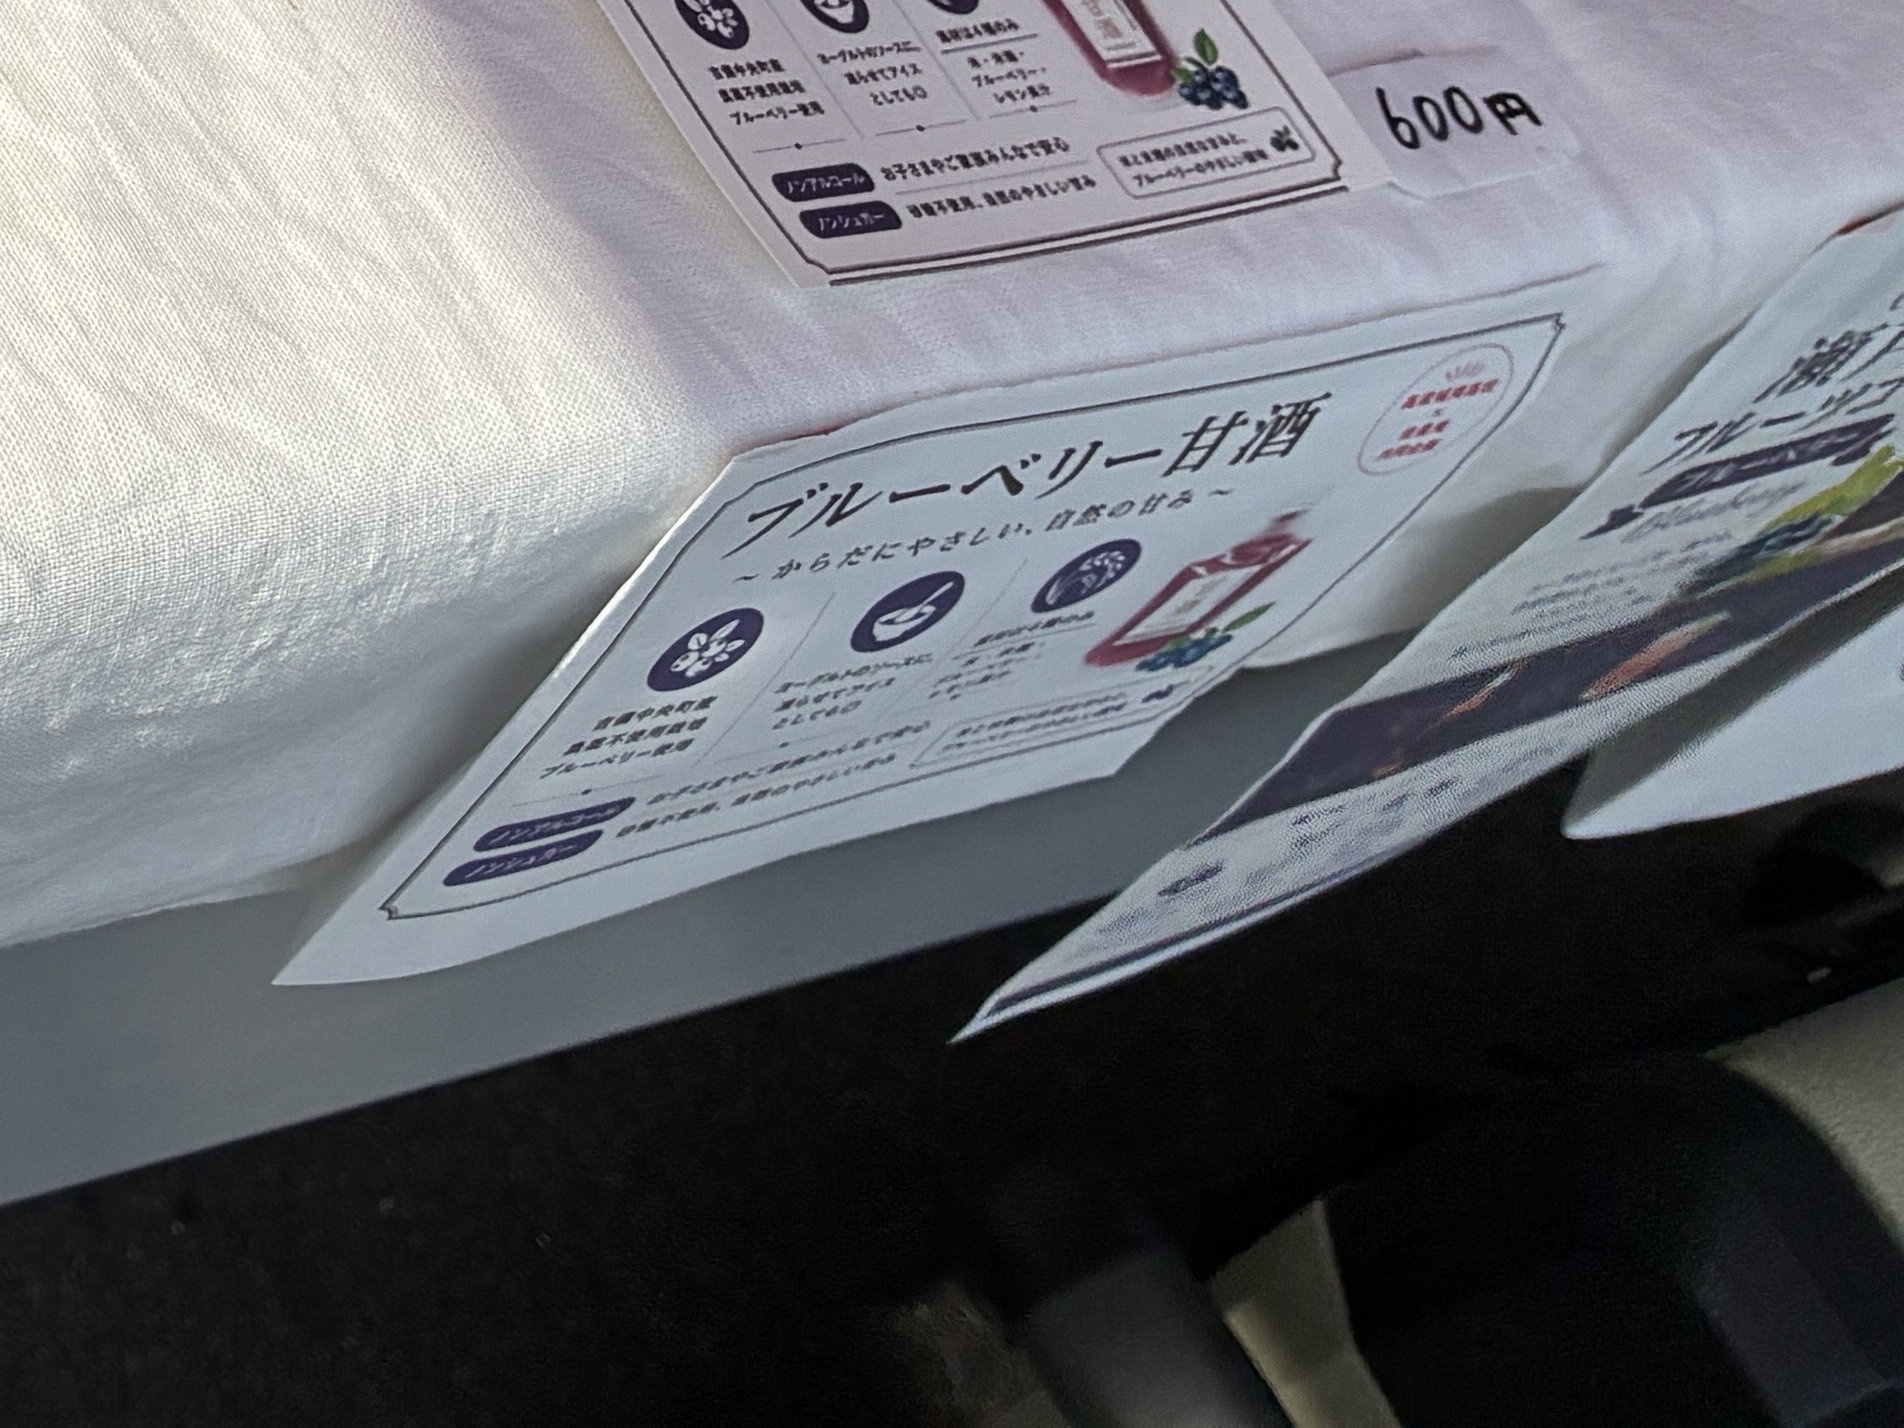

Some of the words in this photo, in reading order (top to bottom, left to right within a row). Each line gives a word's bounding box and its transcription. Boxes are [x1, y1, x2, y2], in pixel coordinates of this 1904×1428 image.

[1375, 84, 1544, 150] 600円
[720, 390, 1334, 561] ブルーベリー甘酒
